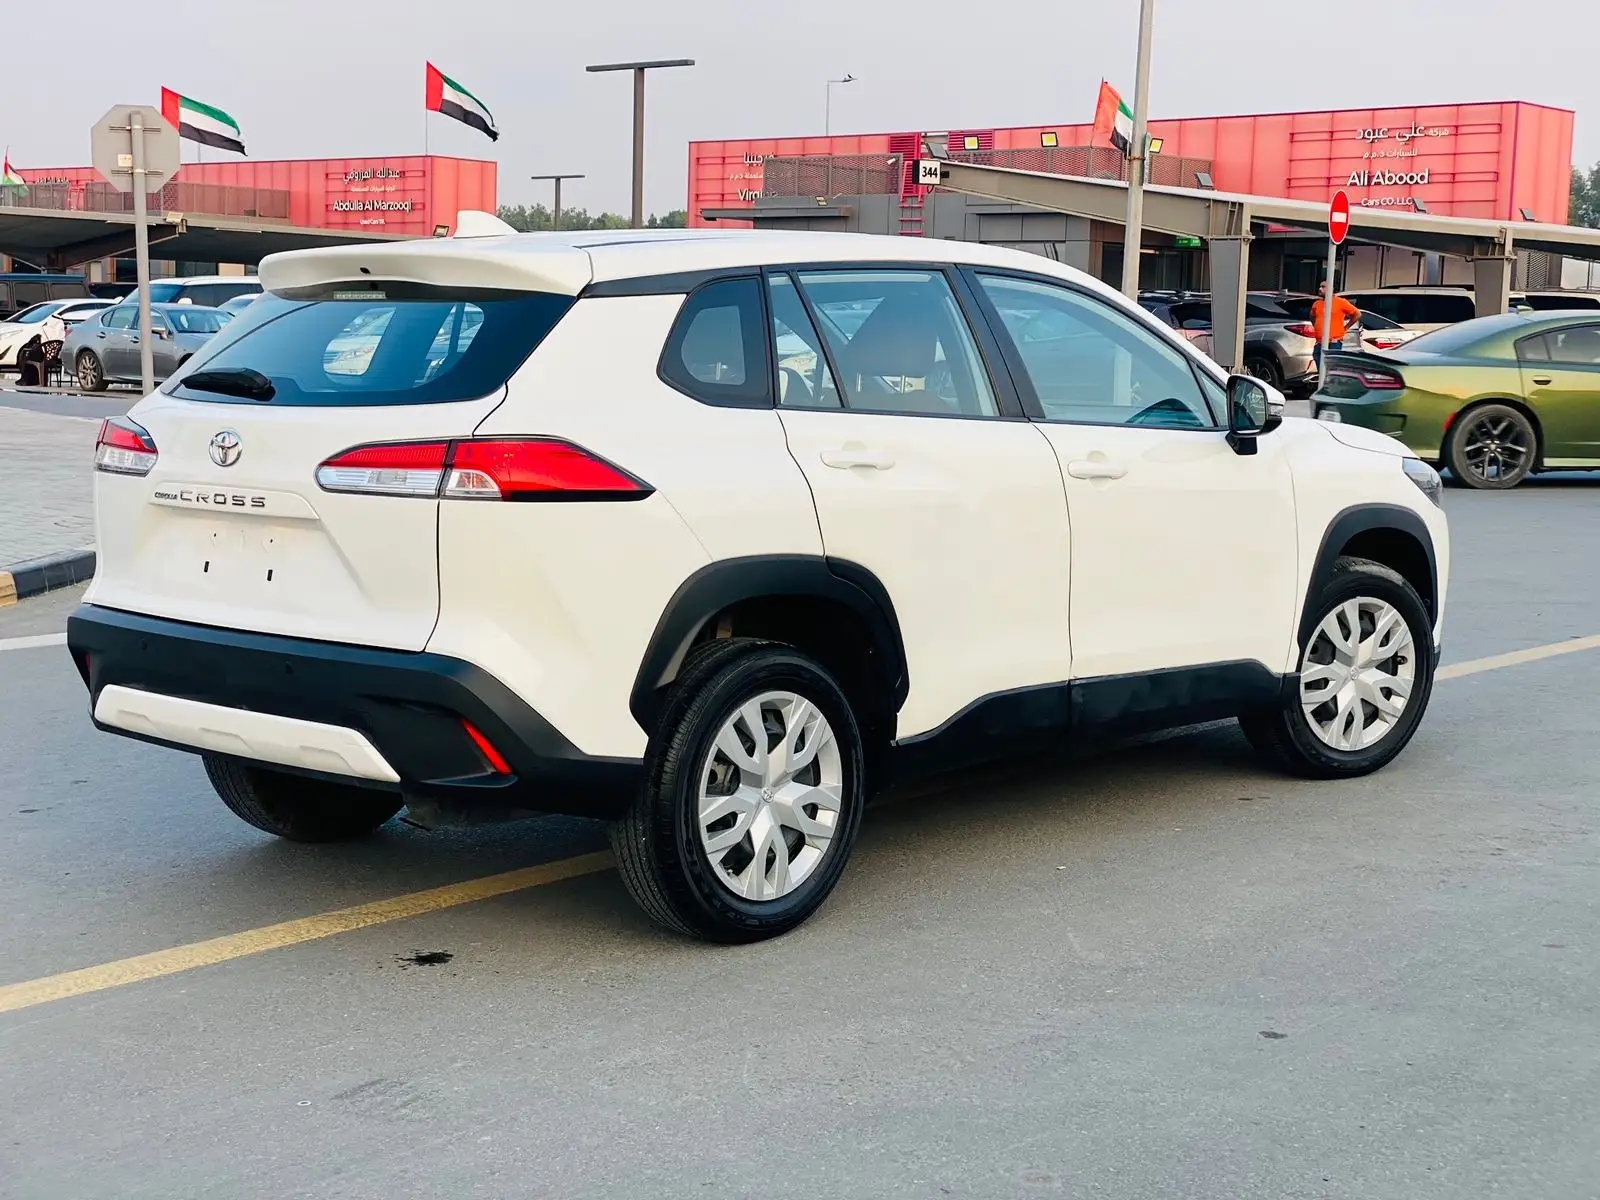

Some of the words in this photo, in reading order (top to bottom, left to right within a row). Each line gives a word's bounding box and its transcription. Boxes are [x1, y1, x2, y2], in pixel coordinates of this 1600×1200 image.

[1355, 127, 1389, 143] عبود
[1396, 121, 1425, 145] علي
[921, 166, 938, 178] 344
[1347, 169, 1369, 186] Ali
[1371, 167, 1430, 186] Abood
[333, 199, 363, 211] Abdulla
[364, 199, 373, 211] Al
[374, 197, 413, 214] Marzooqi
[1361, 197, 1380, 206] Cars
[180, 490, 266, 508] CROSS
